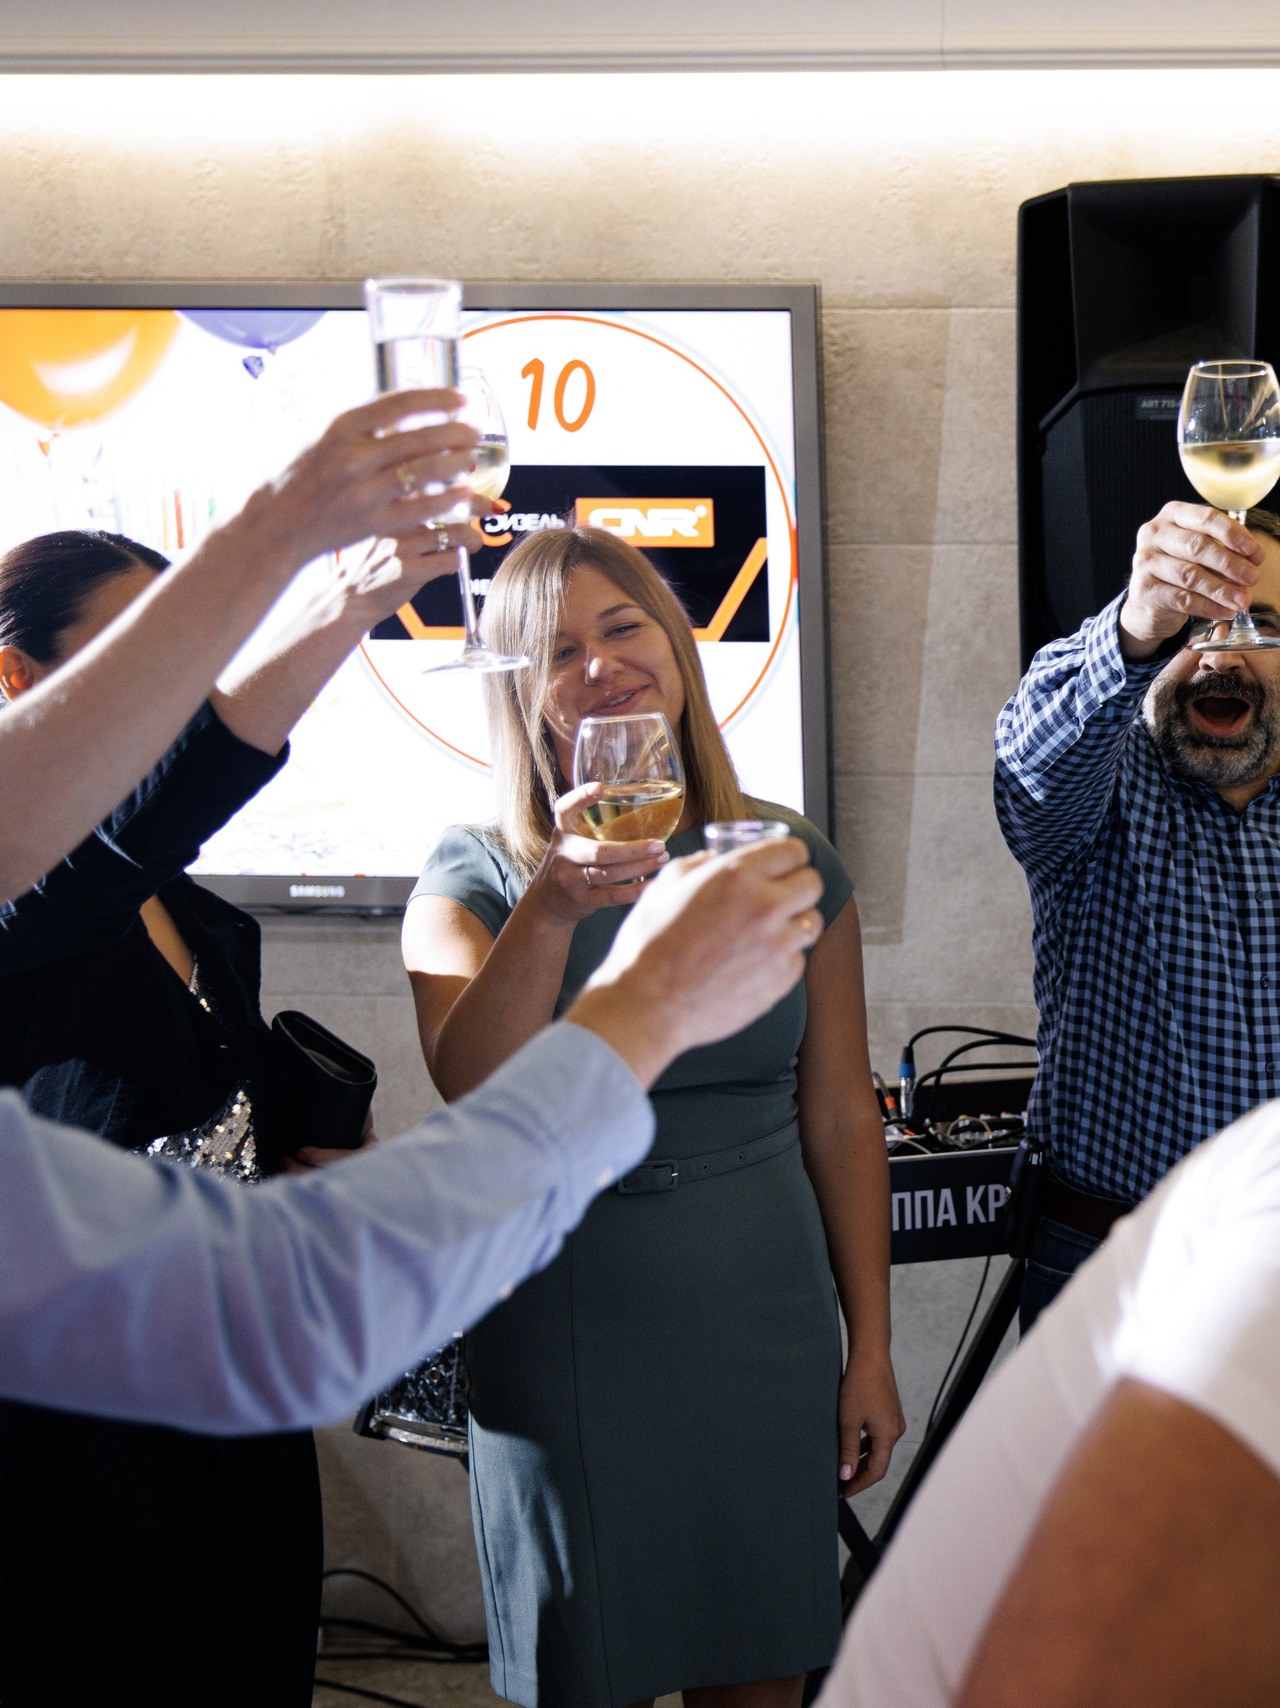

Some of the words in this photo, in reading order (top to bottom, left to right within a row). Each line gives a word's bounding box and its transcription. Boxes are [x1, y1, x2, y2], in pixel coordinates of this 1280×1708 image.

[521, 358, 596, 432] 10
[290, 885, 345, 898] SAMSUNG
[892, 1188, 957, 1232] ППА
[966, 1184, 1006, 1225] КР
